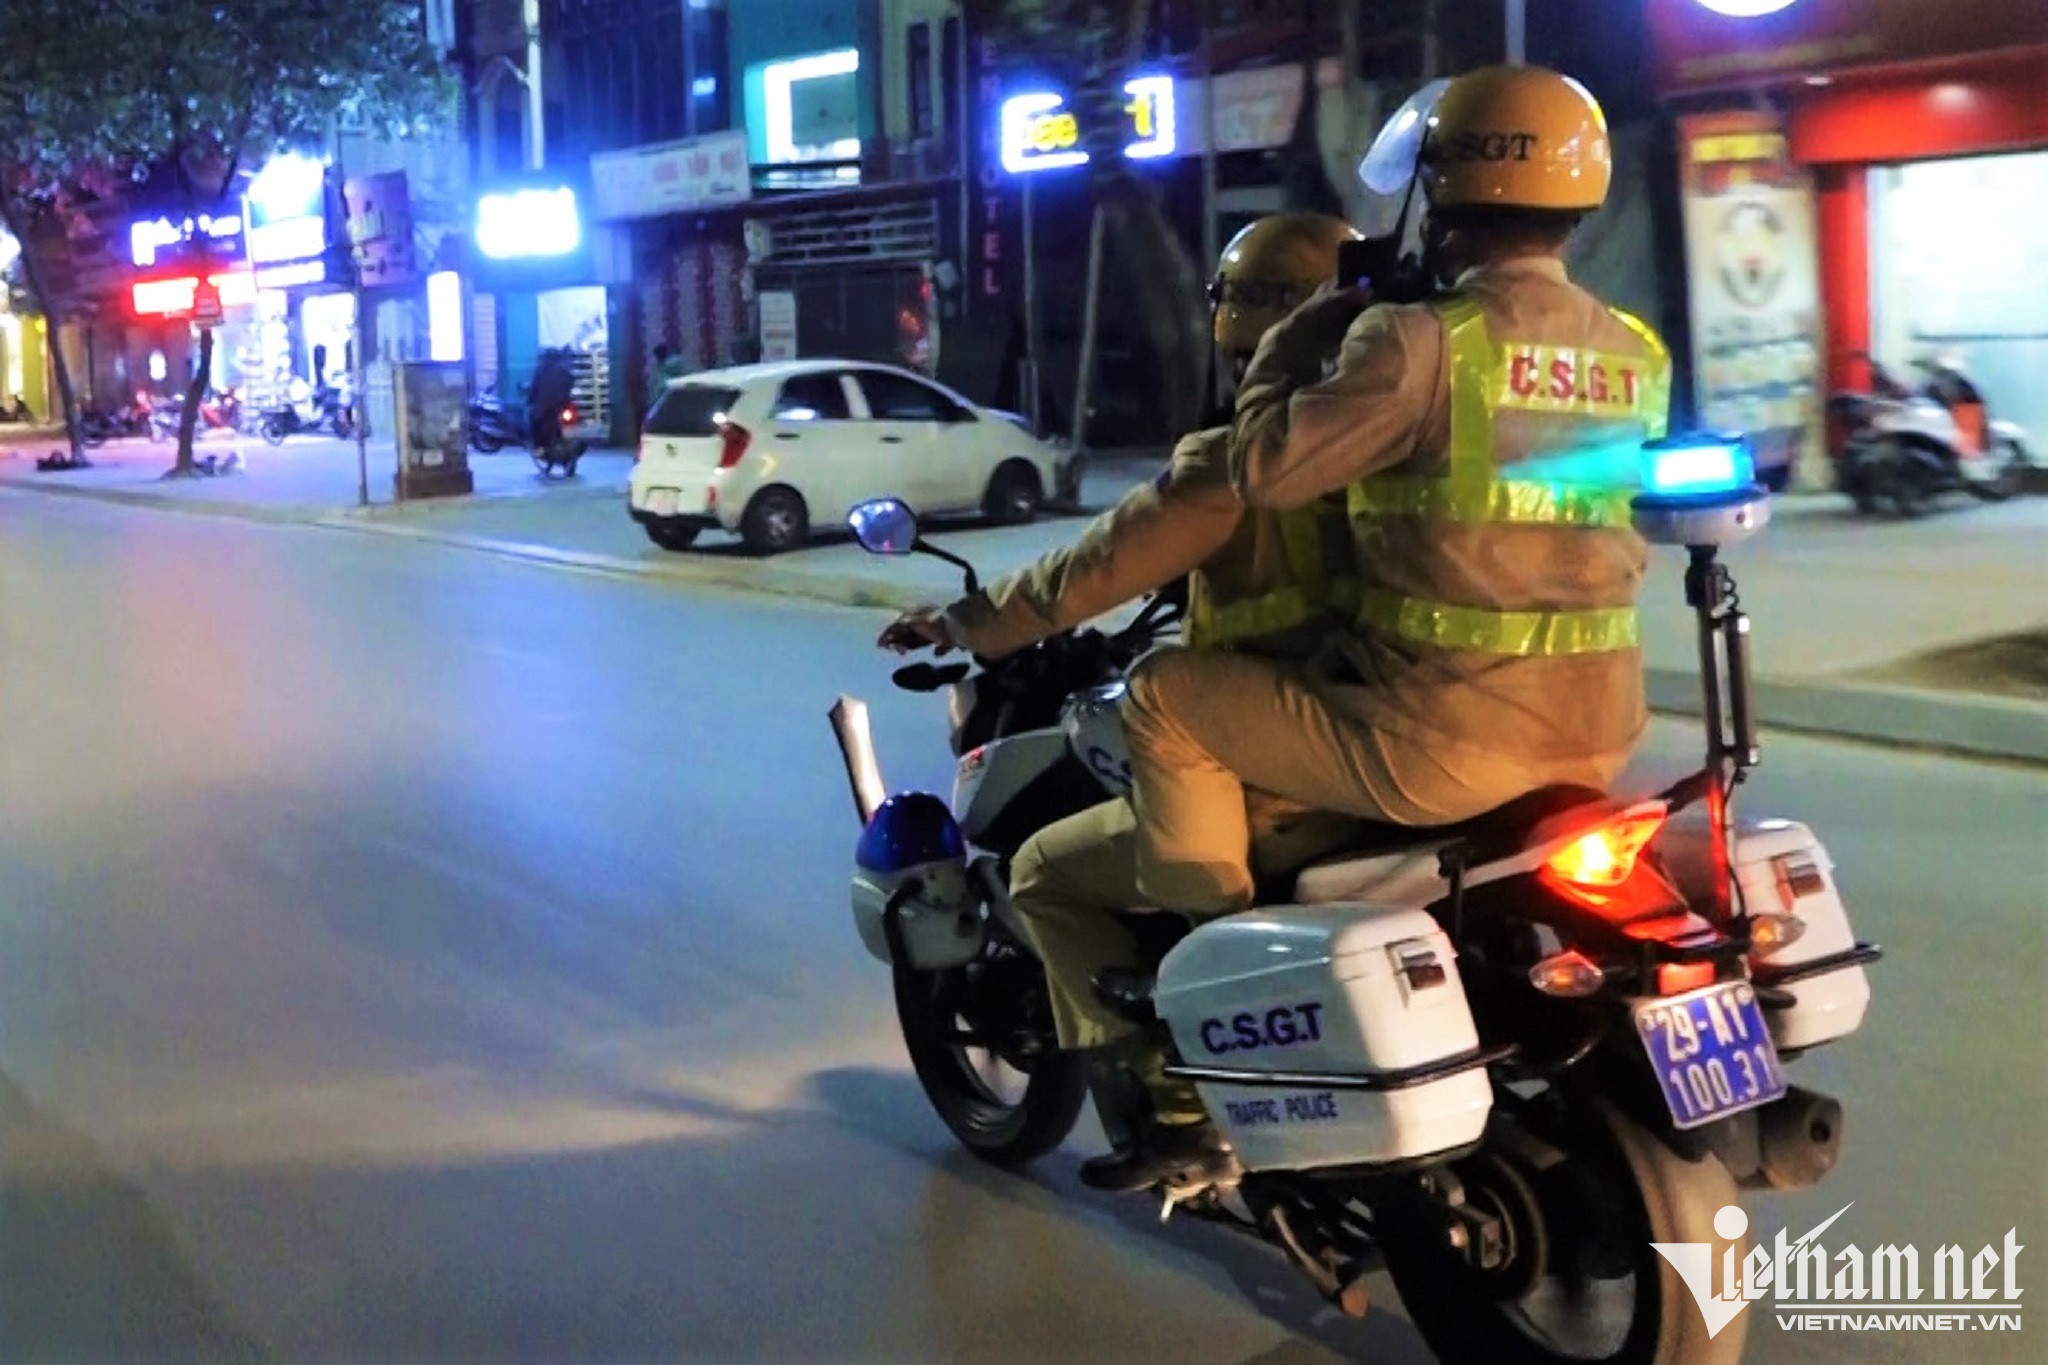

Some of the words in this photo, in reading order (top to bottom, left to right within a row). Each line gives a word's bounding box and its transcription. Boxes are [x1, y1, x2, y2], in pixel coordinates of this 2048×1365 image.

[1510, 356, 1636, 405] C.S.G.T
[1201, 1002, 1322, 1055] C.S.G.T
[1670, 1044, 1778, 1117] 100.31
[1225, 1099, 1279, 1125] TRAFFIC
[1285, 1093, 1338, 1121] POLICE
